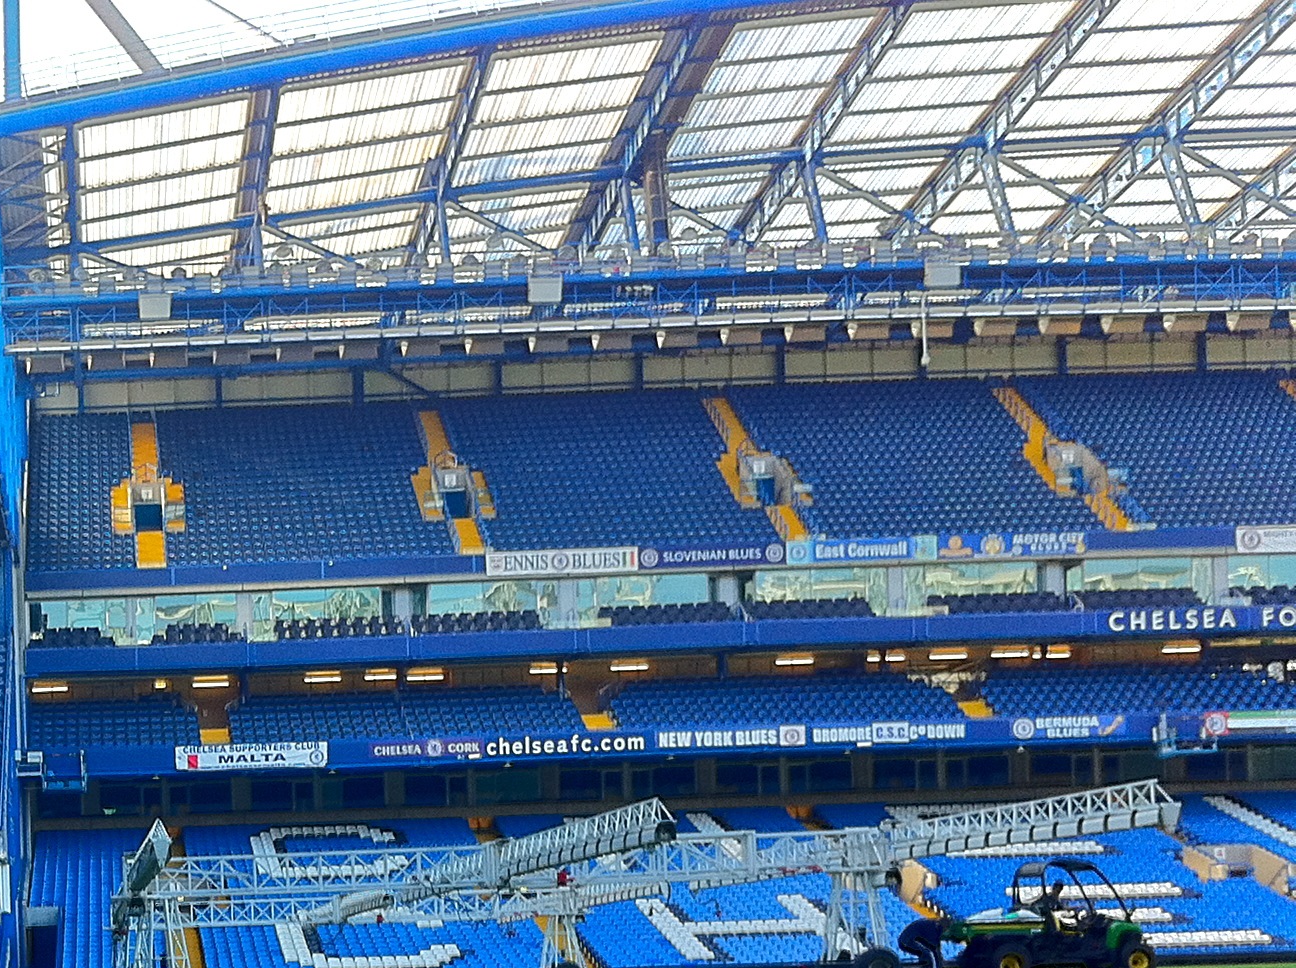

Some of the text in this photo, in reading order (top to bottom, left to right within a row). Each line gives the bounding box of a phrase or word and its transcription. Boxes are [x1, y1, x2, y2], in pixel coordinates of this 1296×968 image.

[663, 547, 762, 563] SLOVENIAN BLUES
[815, 541, 907, 559] East Cornwall
[503, 551, 621, 572] ENNIS BLUES
[1108, 607, 1237, 632] CHELSEA
[1036, 715, 1100, 729] BERMUDA
[659, 729, 777, 748] NEW YORK BLUES
[1046, 727, 1090, 738] BLUES
[183, 741, 320, 754] CHELSEA SUPPORTERS CLUB
[373, 742, 479, 757] CHELSEA CORK
[486, 734, 645, 757] chelseafc.com
[218, 752, 286, 764] MALTA
